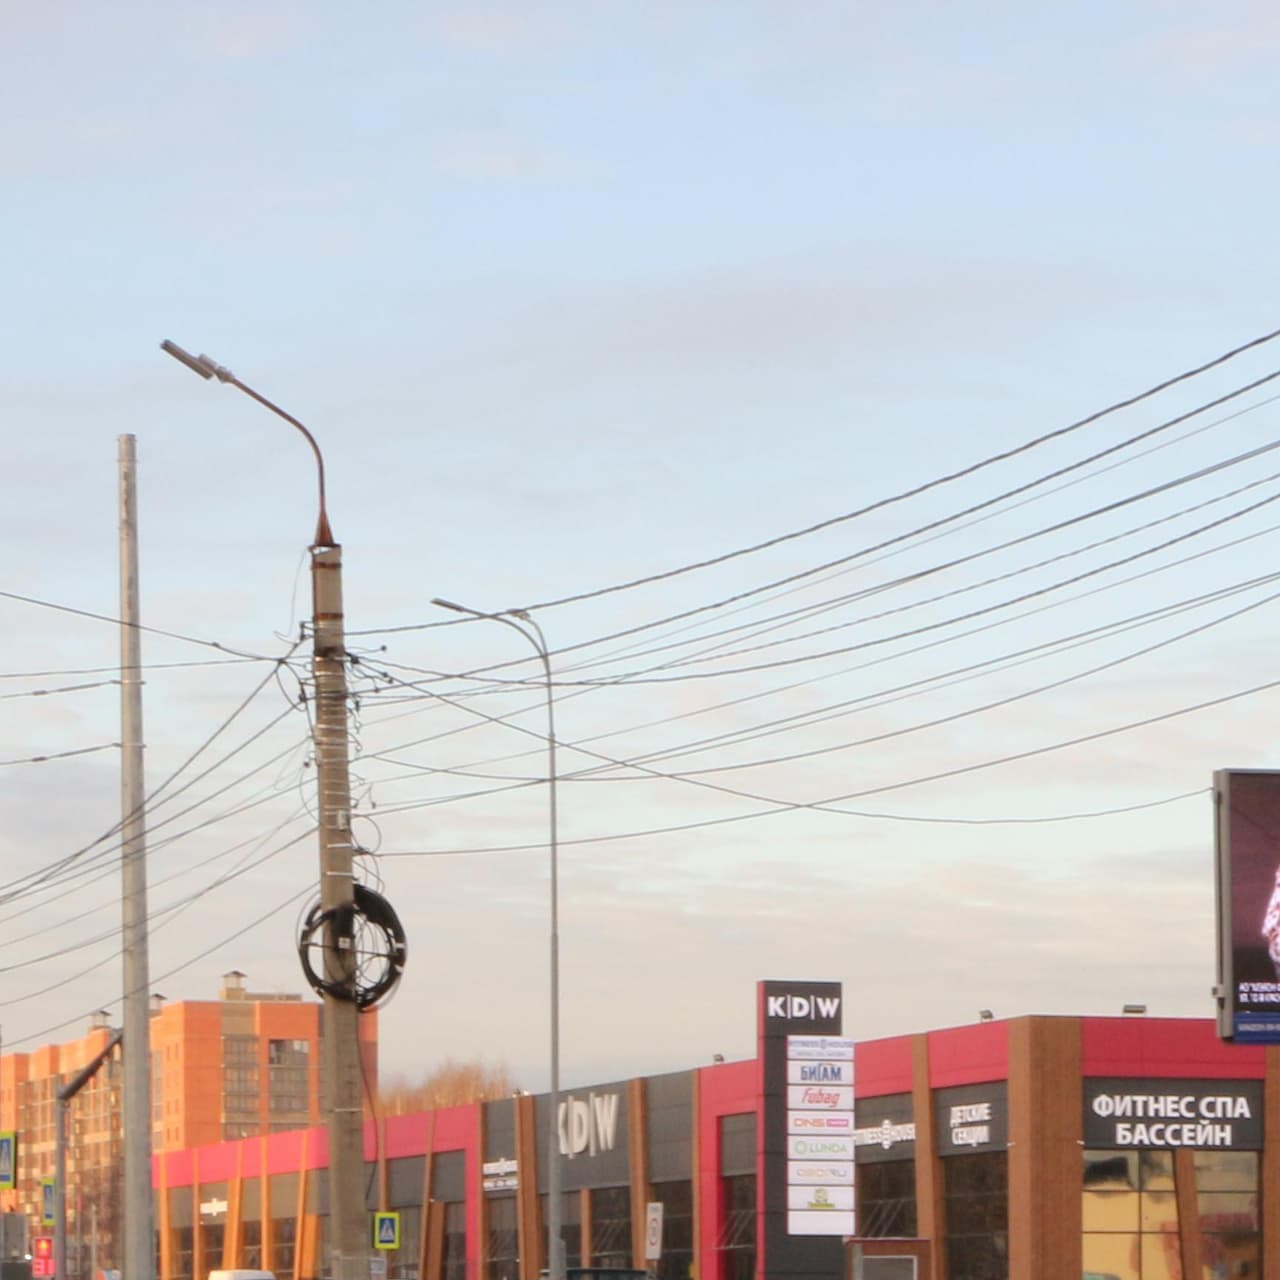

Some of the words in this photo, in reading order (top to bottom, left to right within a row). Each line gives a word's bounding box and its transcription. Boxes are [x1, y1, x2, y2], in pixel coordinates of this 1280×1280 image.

[1092, 1094, 1196, 1118] ФИТНЕС
[1199, 1097, 1252, 1119] СПА
[1115, 1120, 1233, 1146] БАССЕЙН
